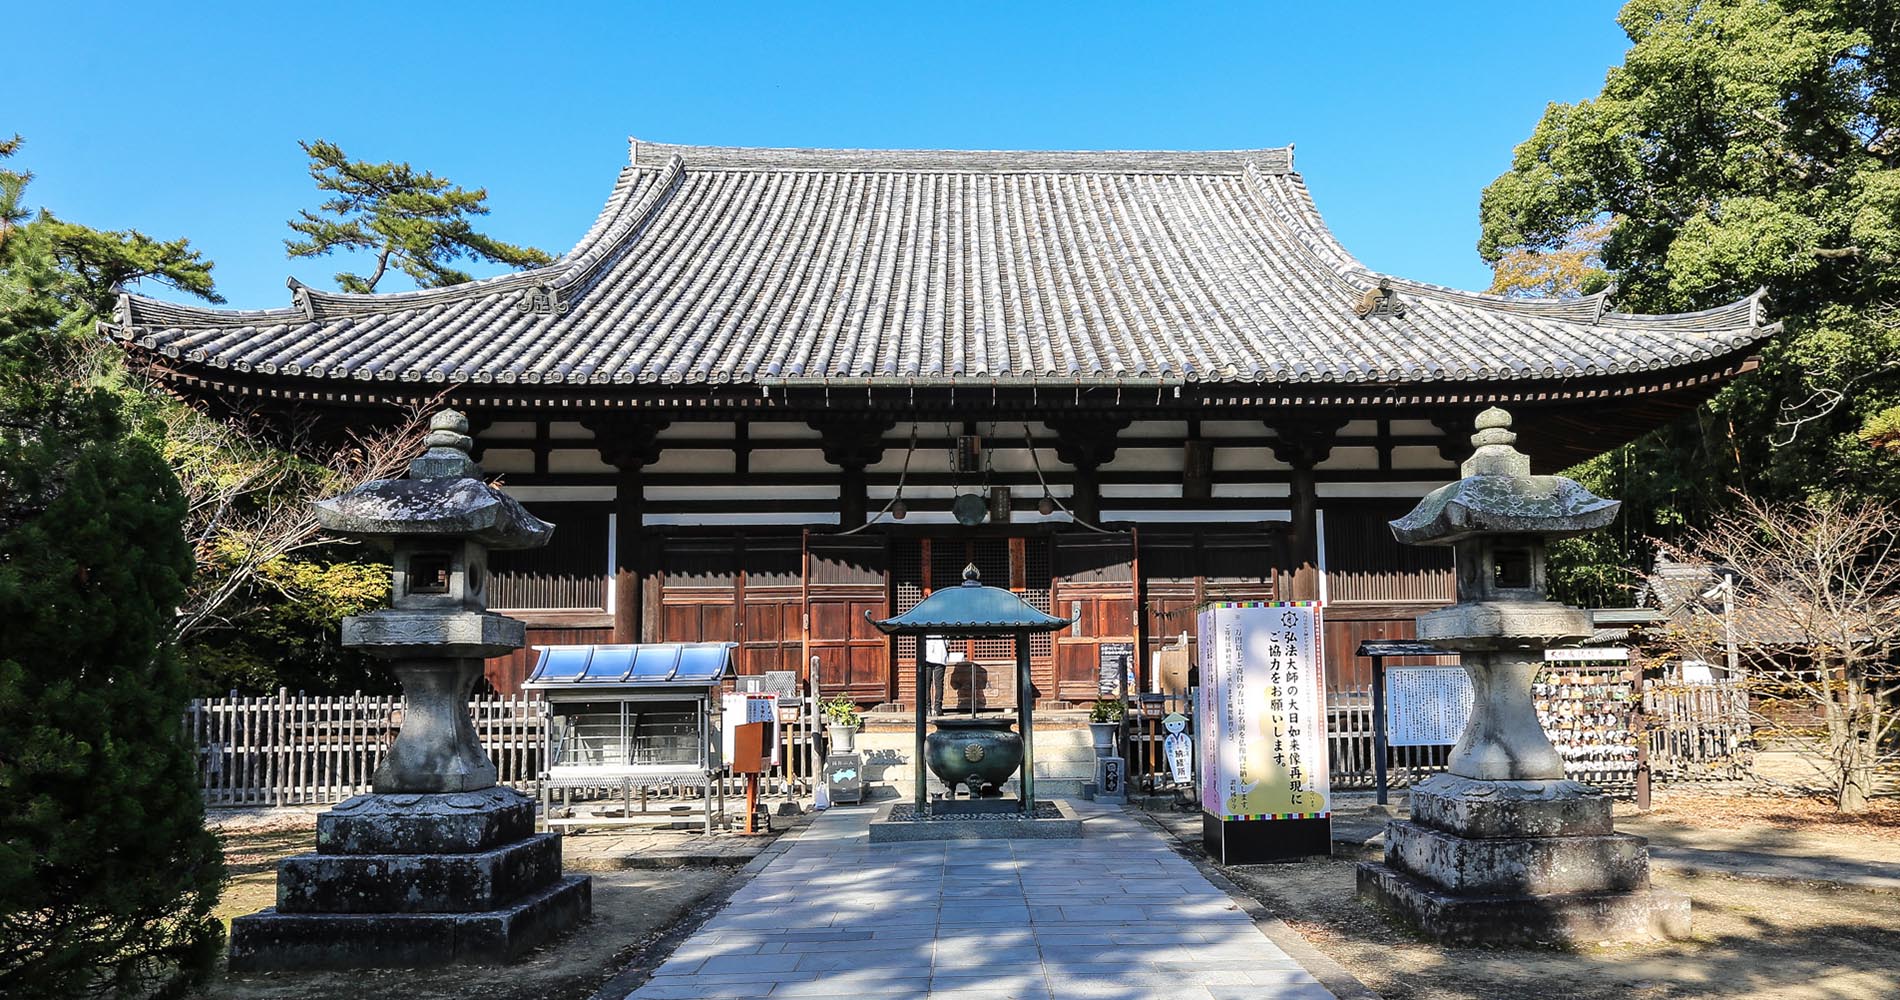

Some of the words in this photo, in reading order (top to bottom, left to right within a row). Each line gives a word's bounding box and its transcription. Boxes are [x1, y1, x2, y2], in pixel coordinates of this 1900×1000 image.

[1268, 631, 1286, 768] ご協力をお願いします。
[1284, 631, 1303, 805] 弘法大師の大日如来像再現に
